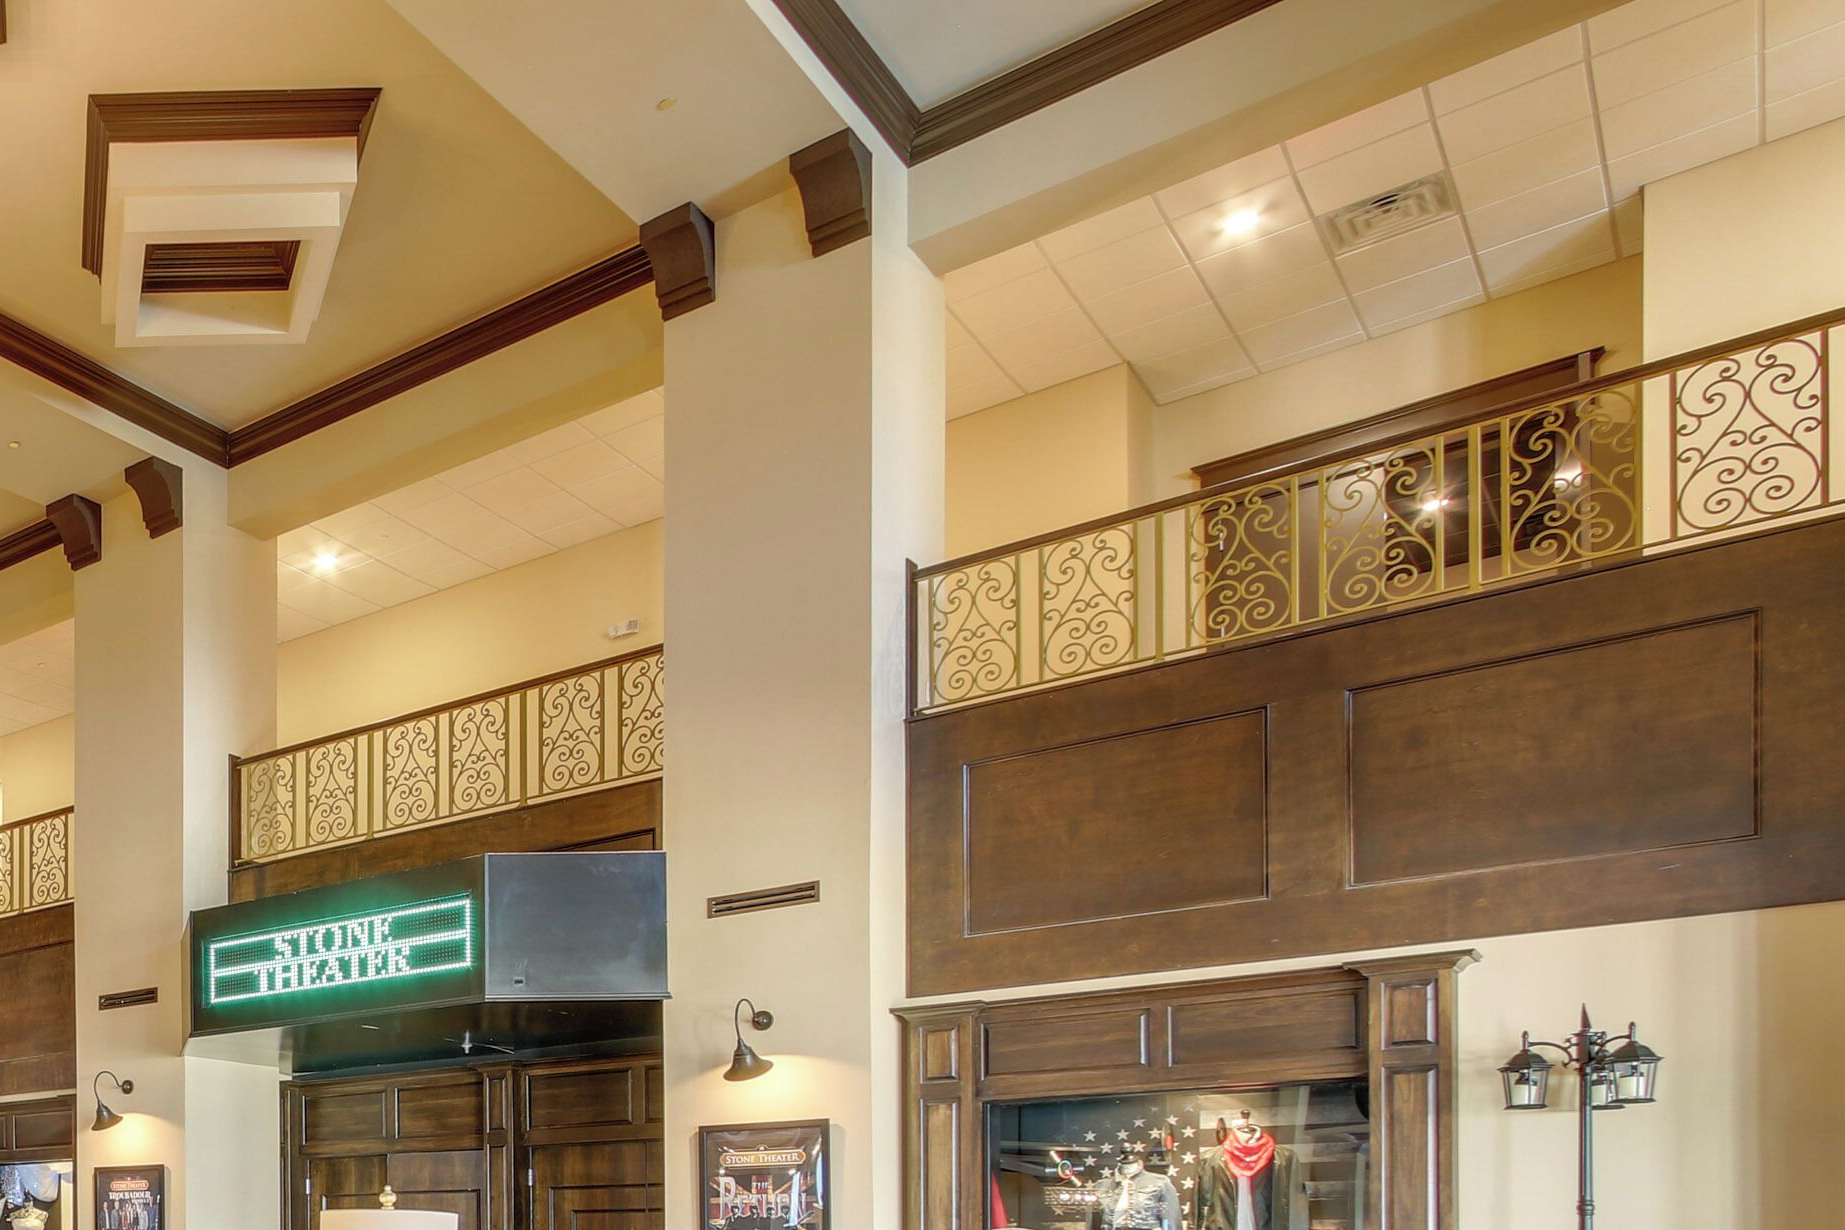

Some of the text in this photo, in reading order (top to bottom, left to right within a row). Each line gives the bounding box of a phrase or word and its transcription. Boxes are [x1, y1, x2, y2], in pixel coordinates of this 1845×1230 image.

[274, 916, 393, 961] STONE
[255, 945, 410, 994] THEATER
[725, 1152, 800, 1164] STONE THEATER
